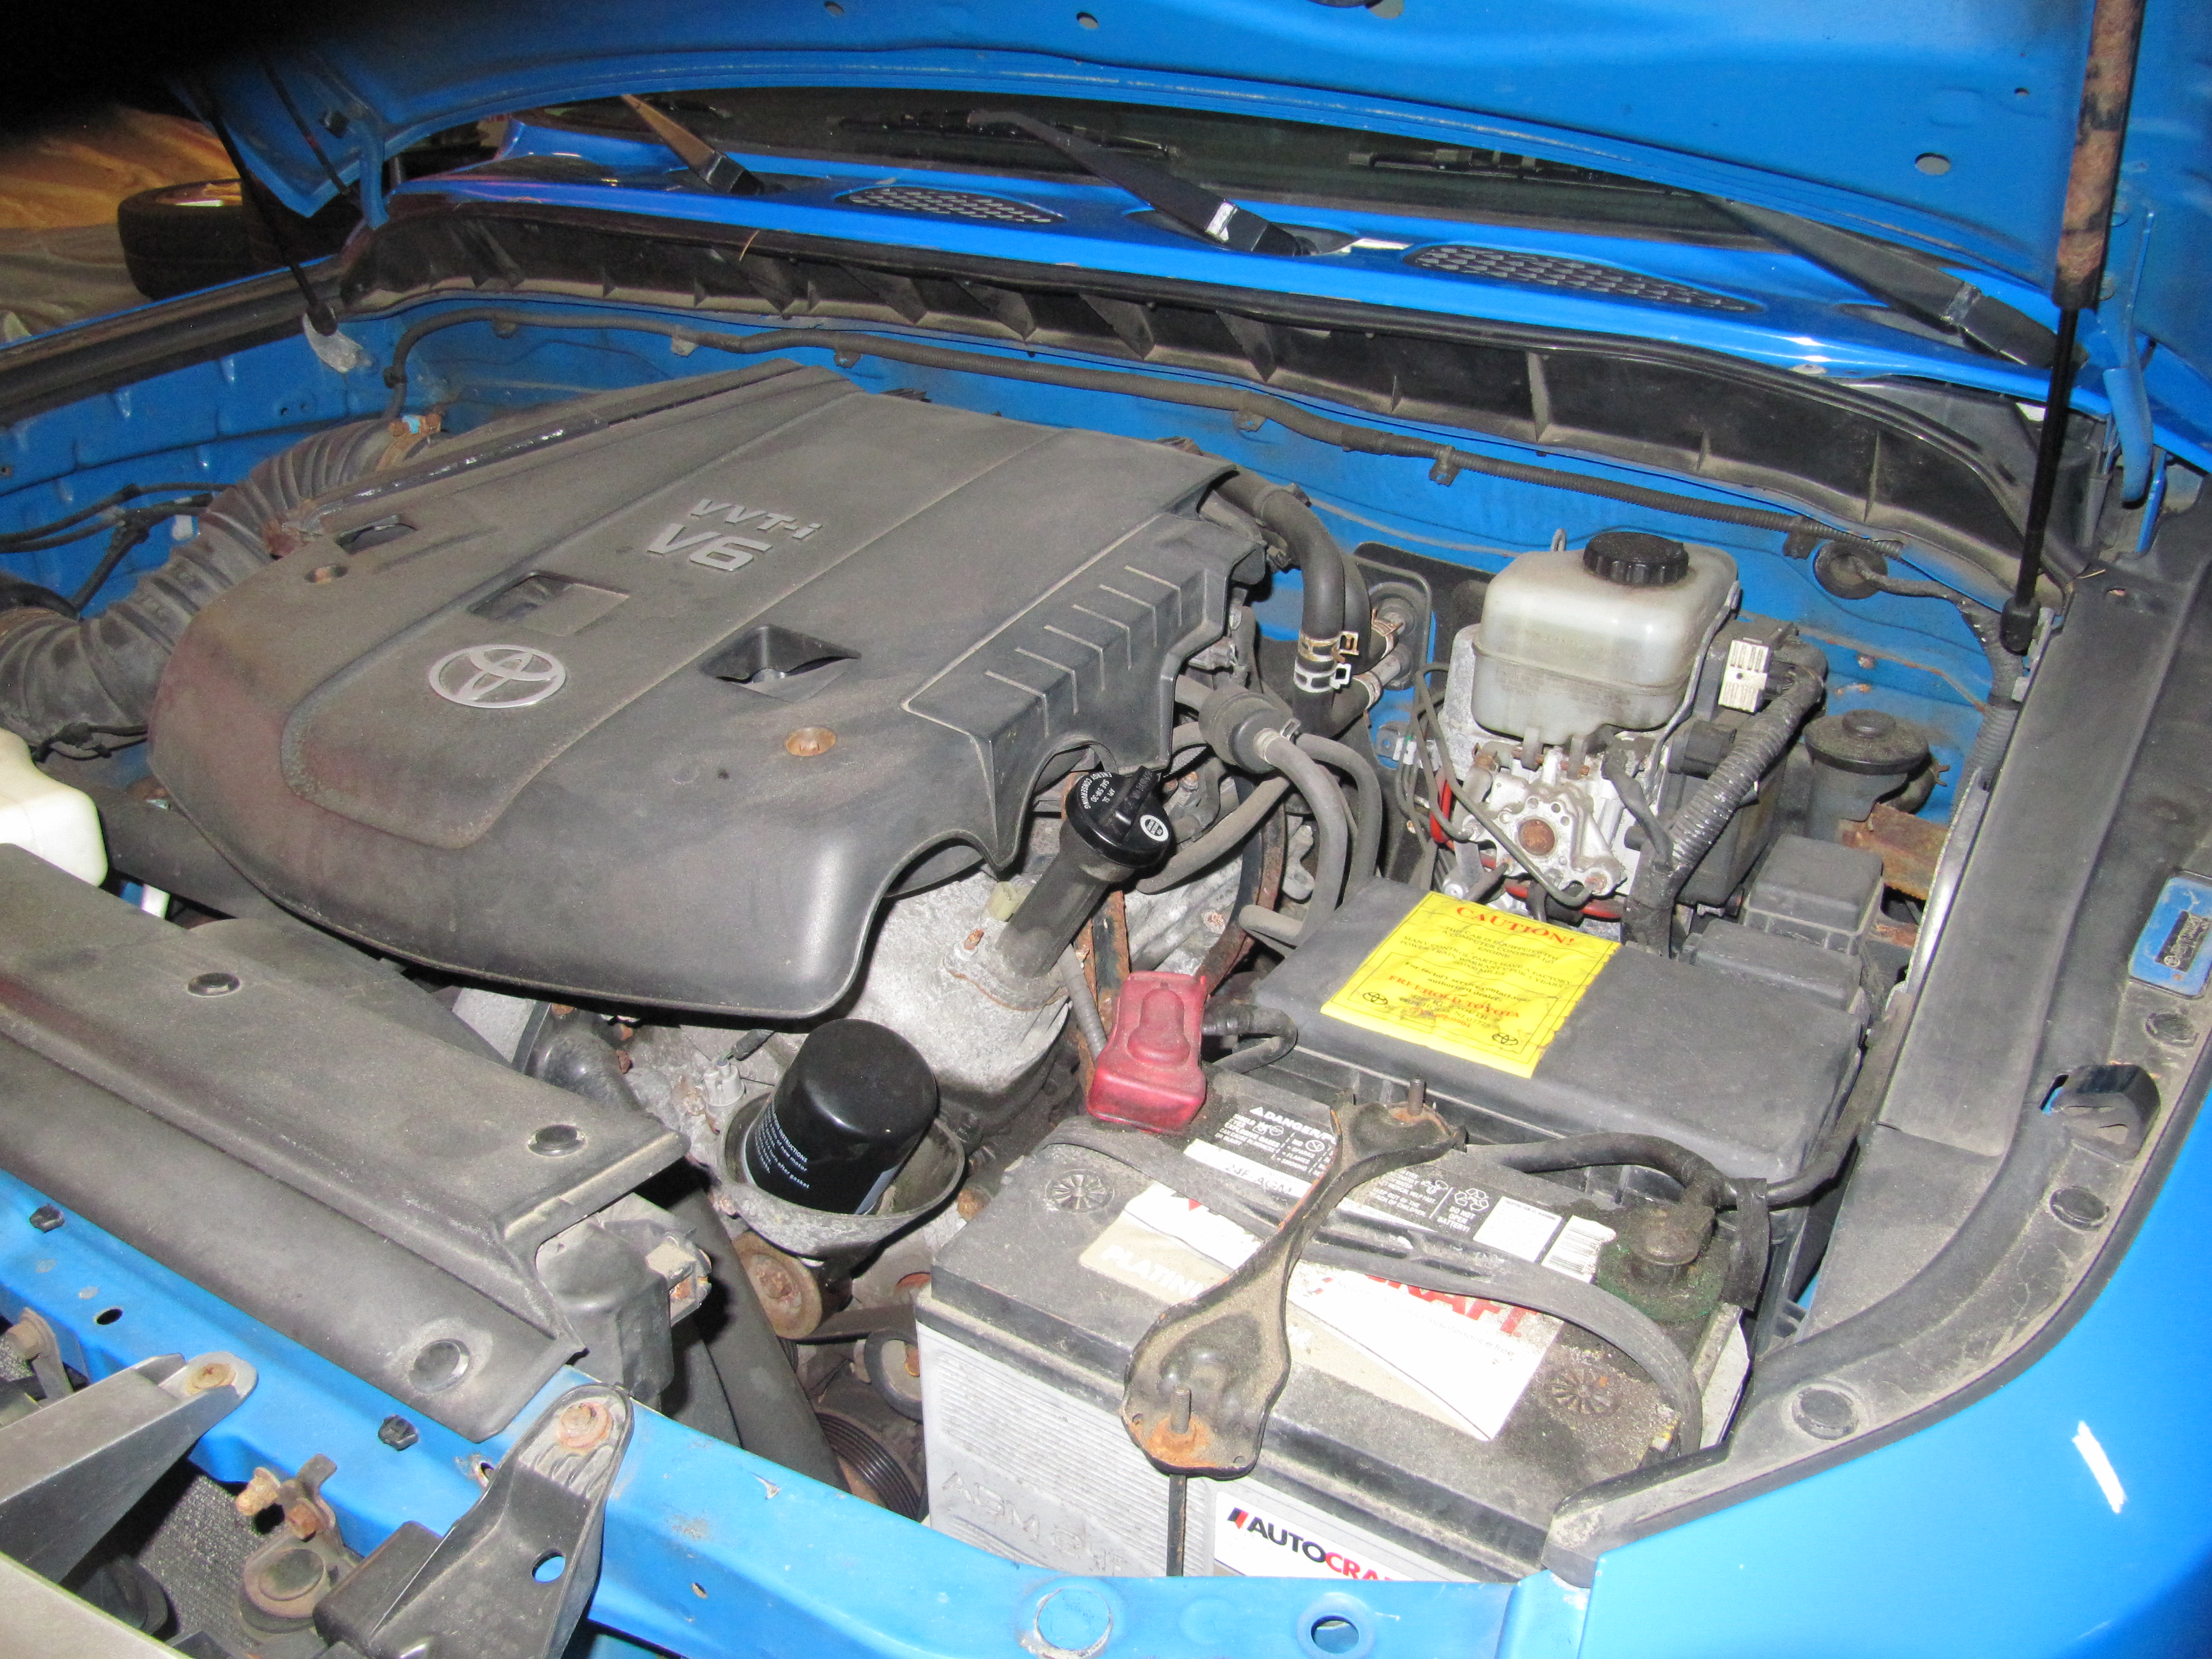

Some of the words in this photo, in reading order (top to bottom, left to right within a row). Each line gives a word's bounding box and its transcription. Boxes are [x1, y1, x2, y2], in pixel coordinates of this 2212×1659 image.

[690, 499, 822, 540] VVT-i
[647, 523, 773, 571] V6
[1090, 771, 1113, 780] ENERGY
[1100, 779, 1109, 789] SAE
[1081, 778, 1093, 809] CONSERVING
[1091, 787, 1104, 802] 5W-30
[1107, 788, 1115, 797] API
[1457, 907, 1575, 946] CAUTION!
[1449, 932, 1496, 948] COMPUTER
[1496, 946, 1554, 964] CONTROLLED
[1463, 930, 1482, 940] CAR
[1492, 940, 1536, 953] EQUIPPED
[1536, 951, 1558, 960] WITH
[1477, 946, 1510, 958] ENGINE
[1399, 940, 1430, 951] POWER
[1431, 948, 1457, 958] TRAIN
[1458, 957, 1507, 971] WARRANTY
[1509, 968, 1526, 976] FOR
[1533, 978, 1563, 989] YEARS
[1402, 936, 1428, 945] MANY
[1430, 943, 1471, 957] CONTROL
[1471, 955, 1499, 964] PARTS
[1531, 971, 1571, 985] FACTORY
[1405, 961, 1420, 969] For
[1420, 968, 1448, 980] factory
[1451, 979, 1481, 989] service
[1480, 987, 1511, 998] contact
[1427, 978, 1473, 992] authorized
[1387, 975, 1463, 1004] FREEHOLD
[1463, 1000, 1521, 1018] TOYOTA
[1454, 1005, 1488, 1020] SOUTH
[1465, 1017, 1493, 1028] 07728
[1229, 1118, 1246, 1128] EYES
[1233, 1114, 1256, 1125] SHIELD
[1224, 1122, 1260, 1140] EXPLOSIVE
[1258, 1135, 1280, 1147] GASES
[1228, 1130, 1246, 1141] CAUSE
[1244, 1139, 1275, 1152] BLINDNESS
[778, 1128, 808, 1163] INSTRUCTIONS
[1291, 1146, 1316, 1158] SPARKS
[780, 1146, 790, 1157] new
[790, 1156, 807, 1172] motor
[1281, 1158, 1307, 1172] SMOKING
[1286, 1152, 1311, 1164] FLAMES
[770, 1149, 778, 1162] turn
[778, 1161, 790, 1175] after
[789, 1174, 810, 1189] gasket
[1387, 1183, 1408, 1194] MEDICAL
[1409, 1199, 1421, 1208] THE
[1448, 1213, 1468, 1223] OPEN
[1460, 1210, 1476, 1219] NOT
[1437, 1217, 1470, 1232] BATTERY!
[1247, 1516, 1394, 1580] AUTOCRA
